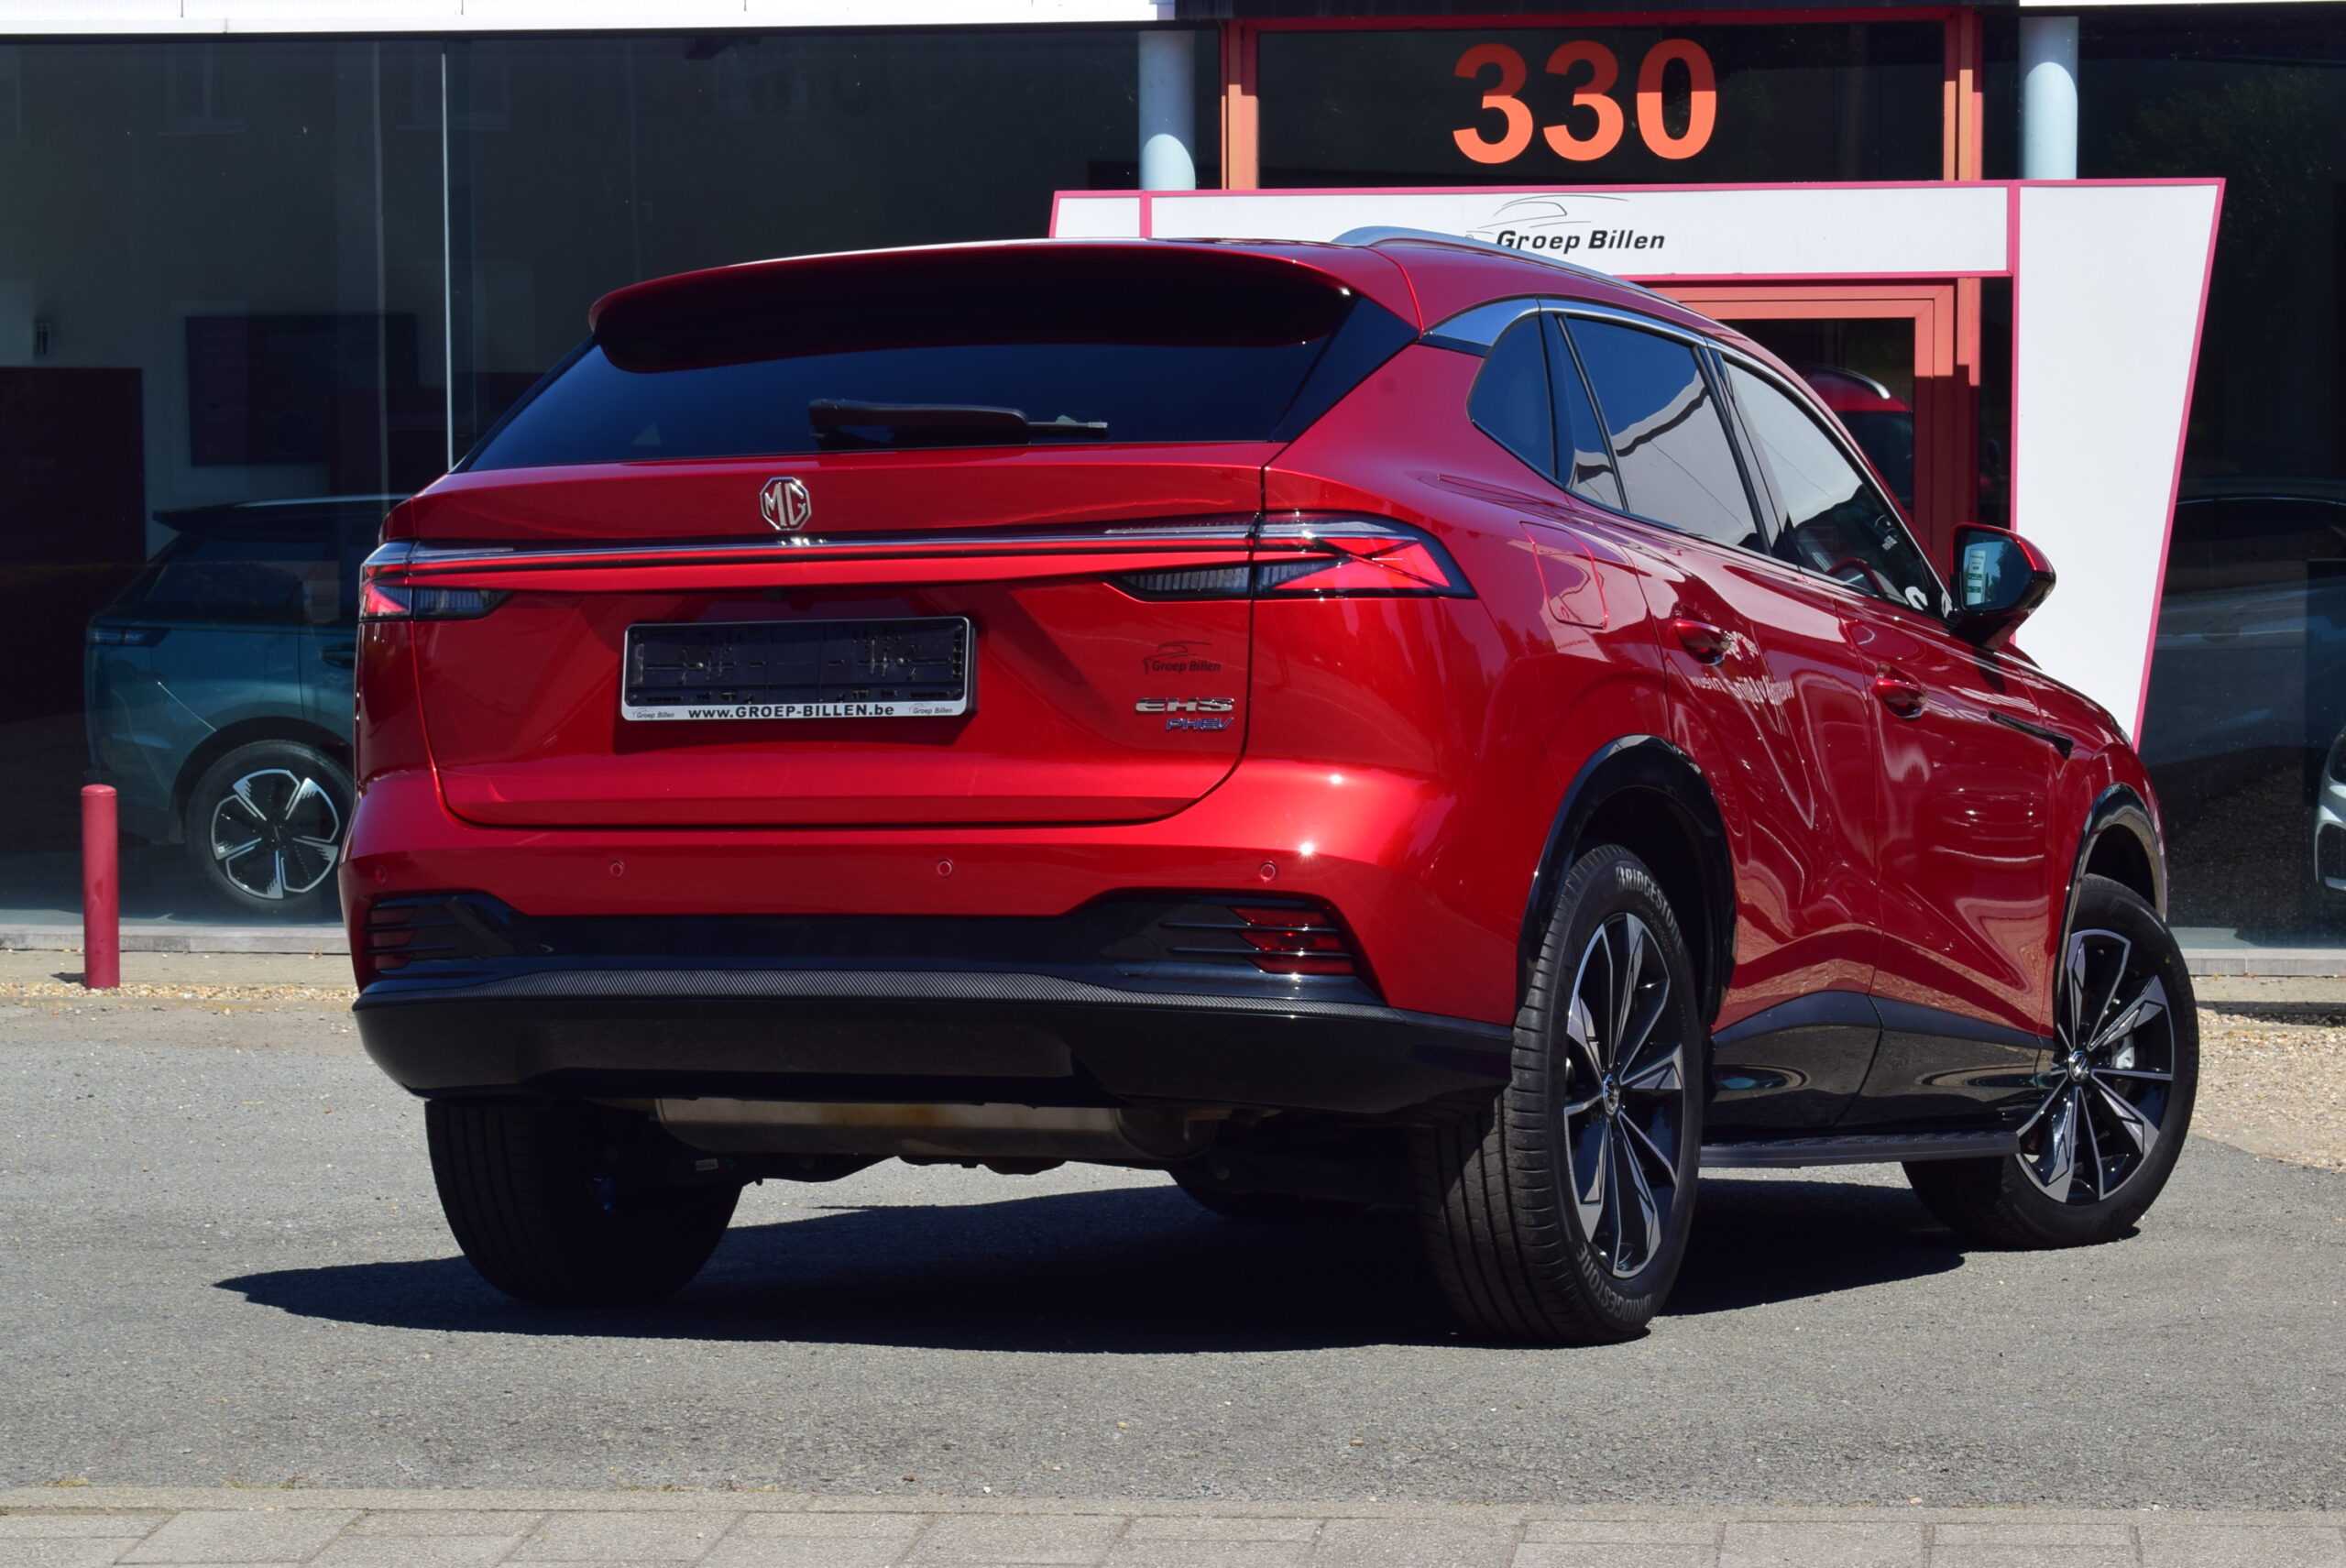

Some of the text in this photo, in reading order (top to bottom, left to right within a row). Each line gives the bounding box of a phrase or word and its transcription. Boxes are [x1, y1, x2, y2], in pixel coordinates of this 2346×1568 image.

[1453, 38, 1717, 164] 330
[1496, 228, 1665, 254] Groep Billen
[762, 481, 807, 528] MG
[1152, 660, 1221, 674] Groep Billen
[688, 704, 895, 719] www.GROEP-BILLEN.be
[934, 707, 953, 715] Billen
[1135, 697, 1234, 712] EHS
[636, 711, 655, 719] Groep
[1166, 717, 1234, 730] PHEV
[1616, 865, 1683, 955] BRIDGESTONE
